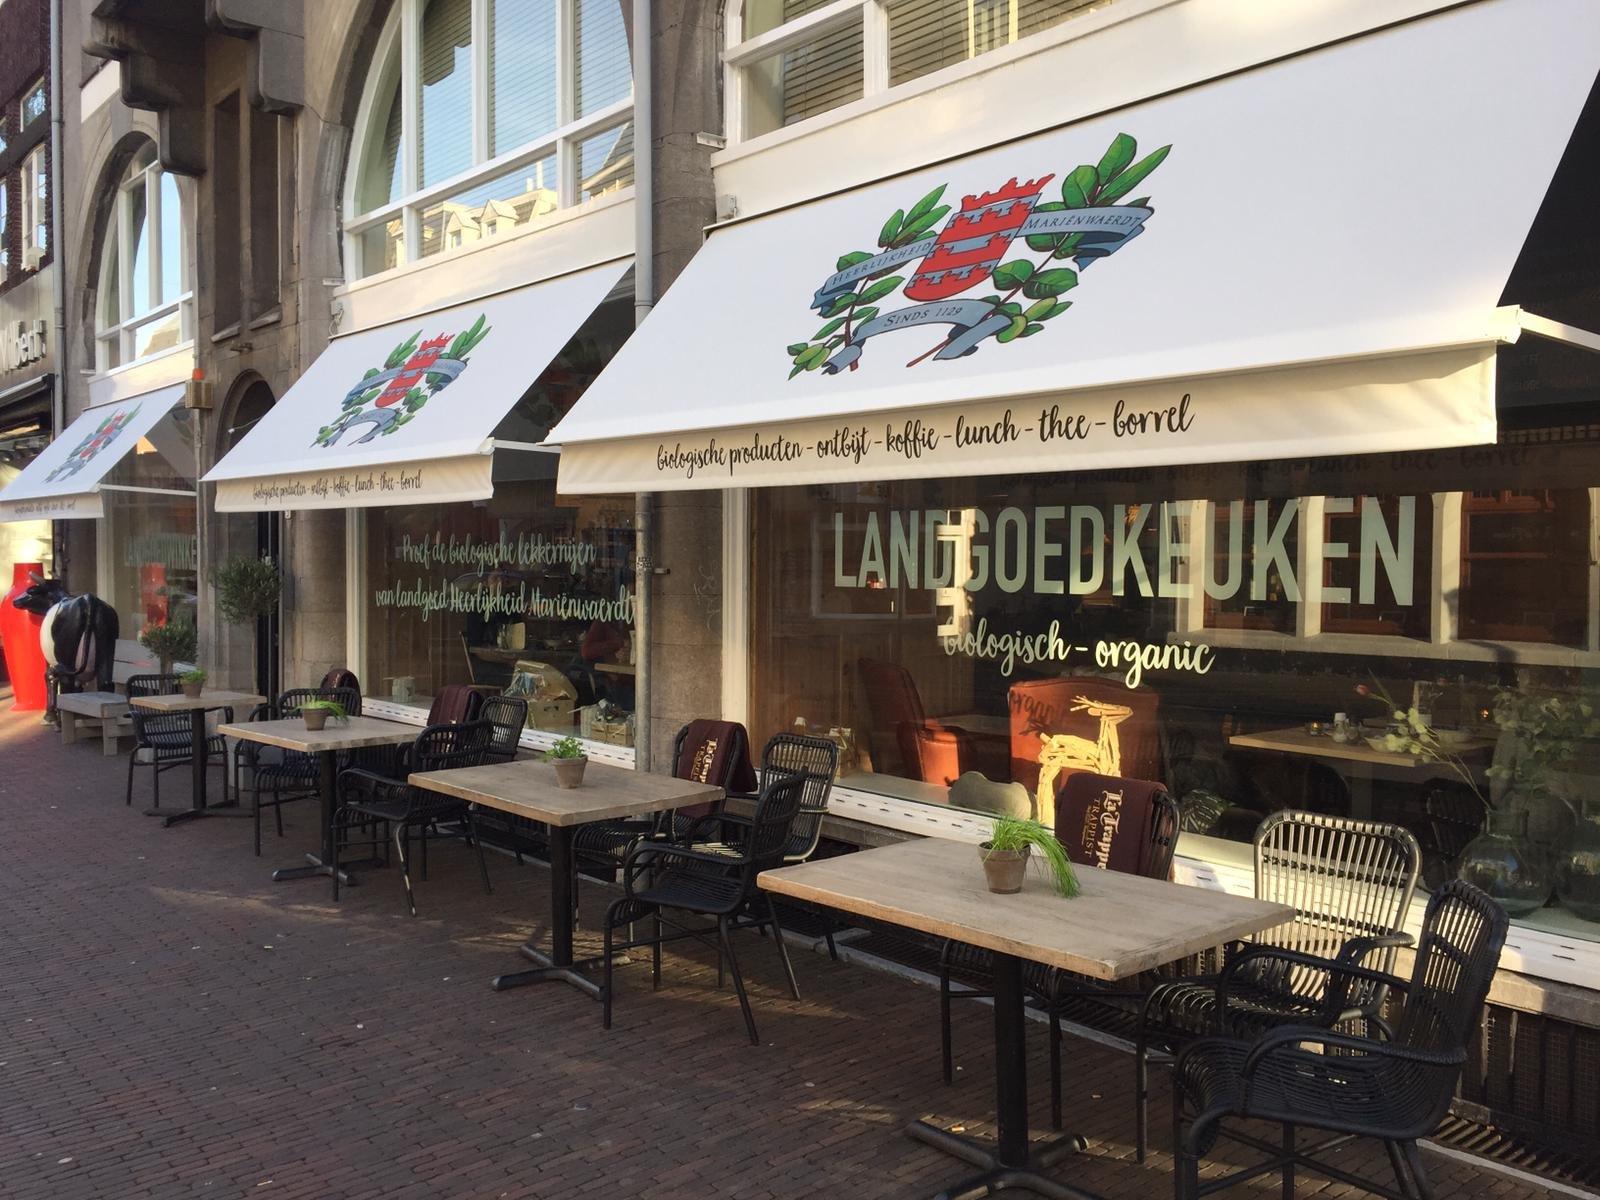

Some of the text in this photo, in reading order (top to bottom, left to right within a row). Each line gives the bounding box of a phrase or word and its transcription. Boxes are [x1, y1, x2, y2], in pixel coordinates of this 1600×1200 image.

[831, 242, 932, 285] HEERLIJKHEID
[883, 305, 964, 327] SINDS 1129
[657, 437, 726, 478] biologische
[728, 433, 803, 476] producten
[816, 424, 870, 464] ontbijt
[886, 418, 940, 459] koffie
[955, 409, 1021, 448] lunch
[1038, 405, 1090, 441] thee
[1112, 393, 1195, 438] borrel
[402, 531, 597, 577] Proef de biologische lekkernijen
[833, 495, 1416, 607] LANDGOEDKEUKEN
[375, 577, 635, 624] van landgoed Heerlijkheid Mariënwaerdt
[944, 618, 1072, 677] biologisch
[1095, 637, 1217, 690] organic
[1102, 789, 1124, 812] La
